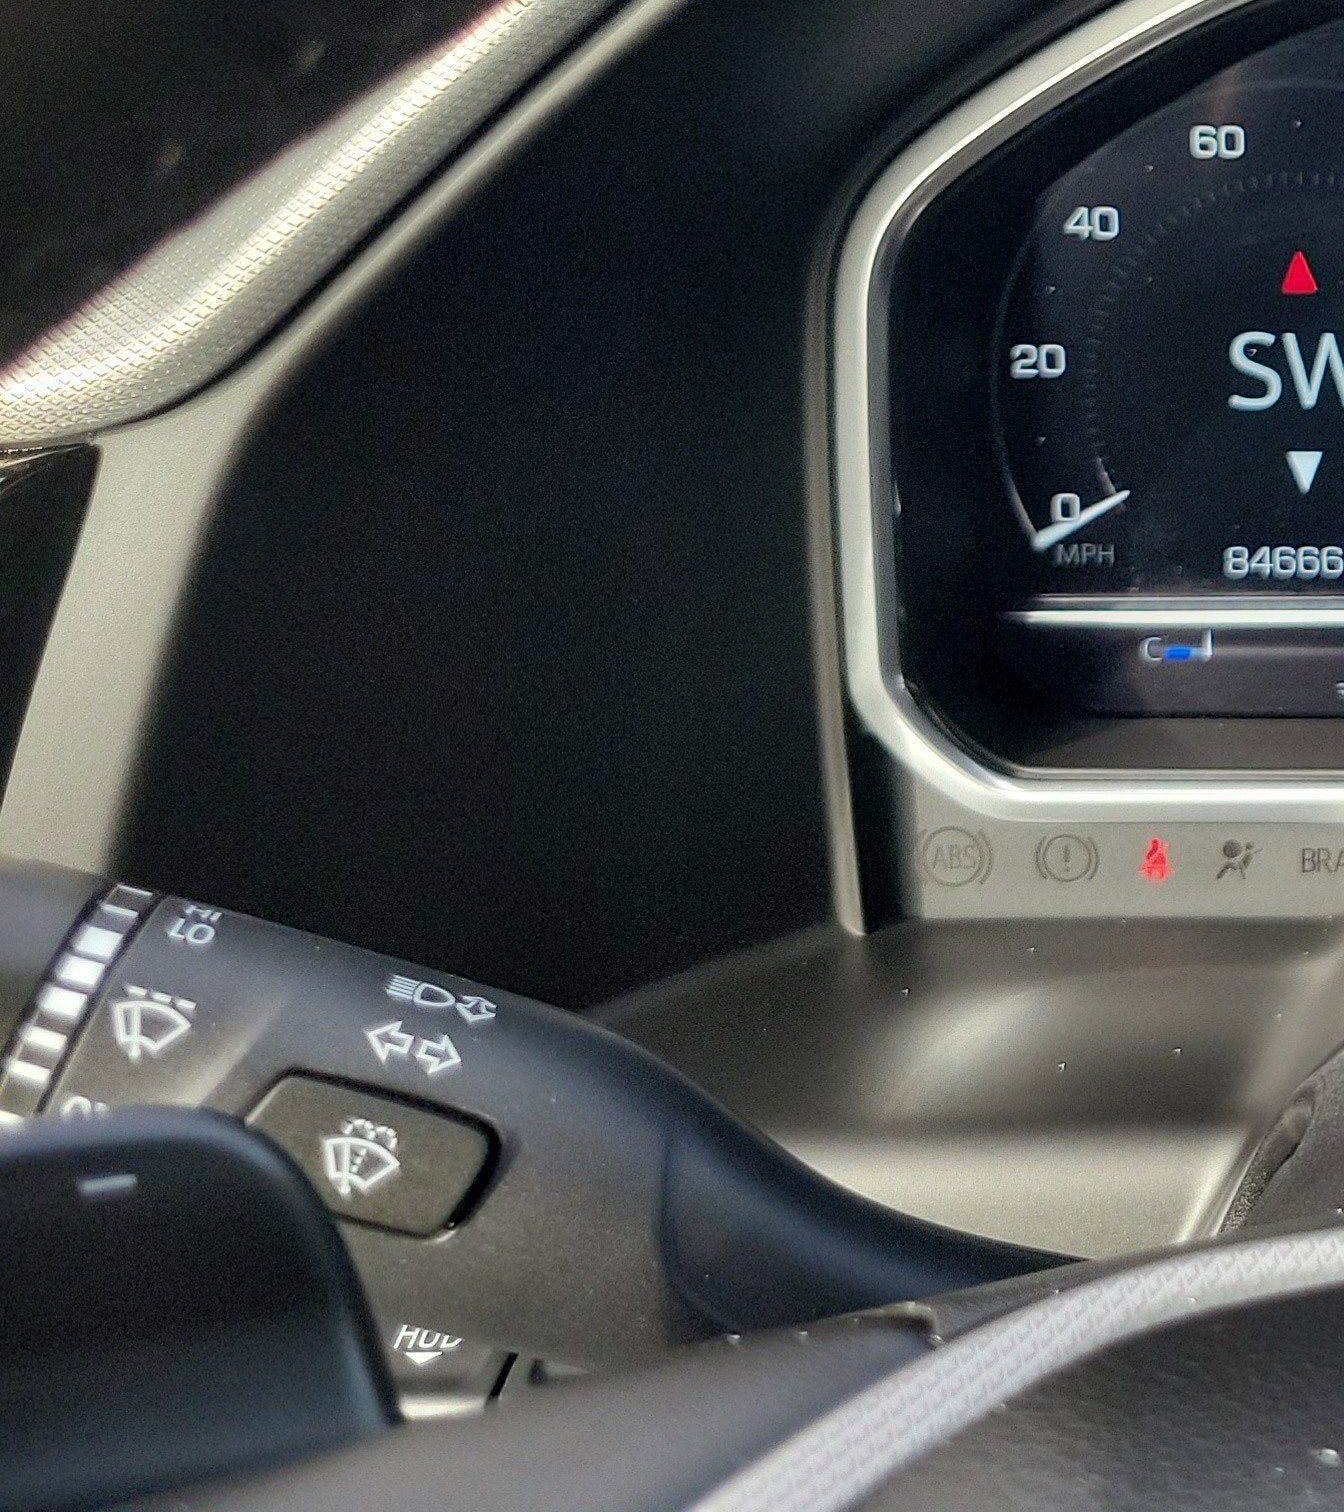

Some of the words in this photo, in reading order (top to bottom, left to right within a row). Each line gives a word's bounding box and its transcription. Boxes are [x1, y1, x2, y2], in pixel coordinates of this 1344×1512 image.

[1189, 124, 1245, 159] 60
[1063, 206, 1120, 240] 40
[1010, 343, 1066, 379] 20
[1050, 493, 1081, 524] 0
[1055, 544, 1115, 565] MPH
[1222, 546, 1344, 579] 84666
[1139, 635, 1163, 665] C
[932, 844, 977, 871] ABS
[167, 917, 215, 944] LO
[393, 1324, 463, 1350] HUD
